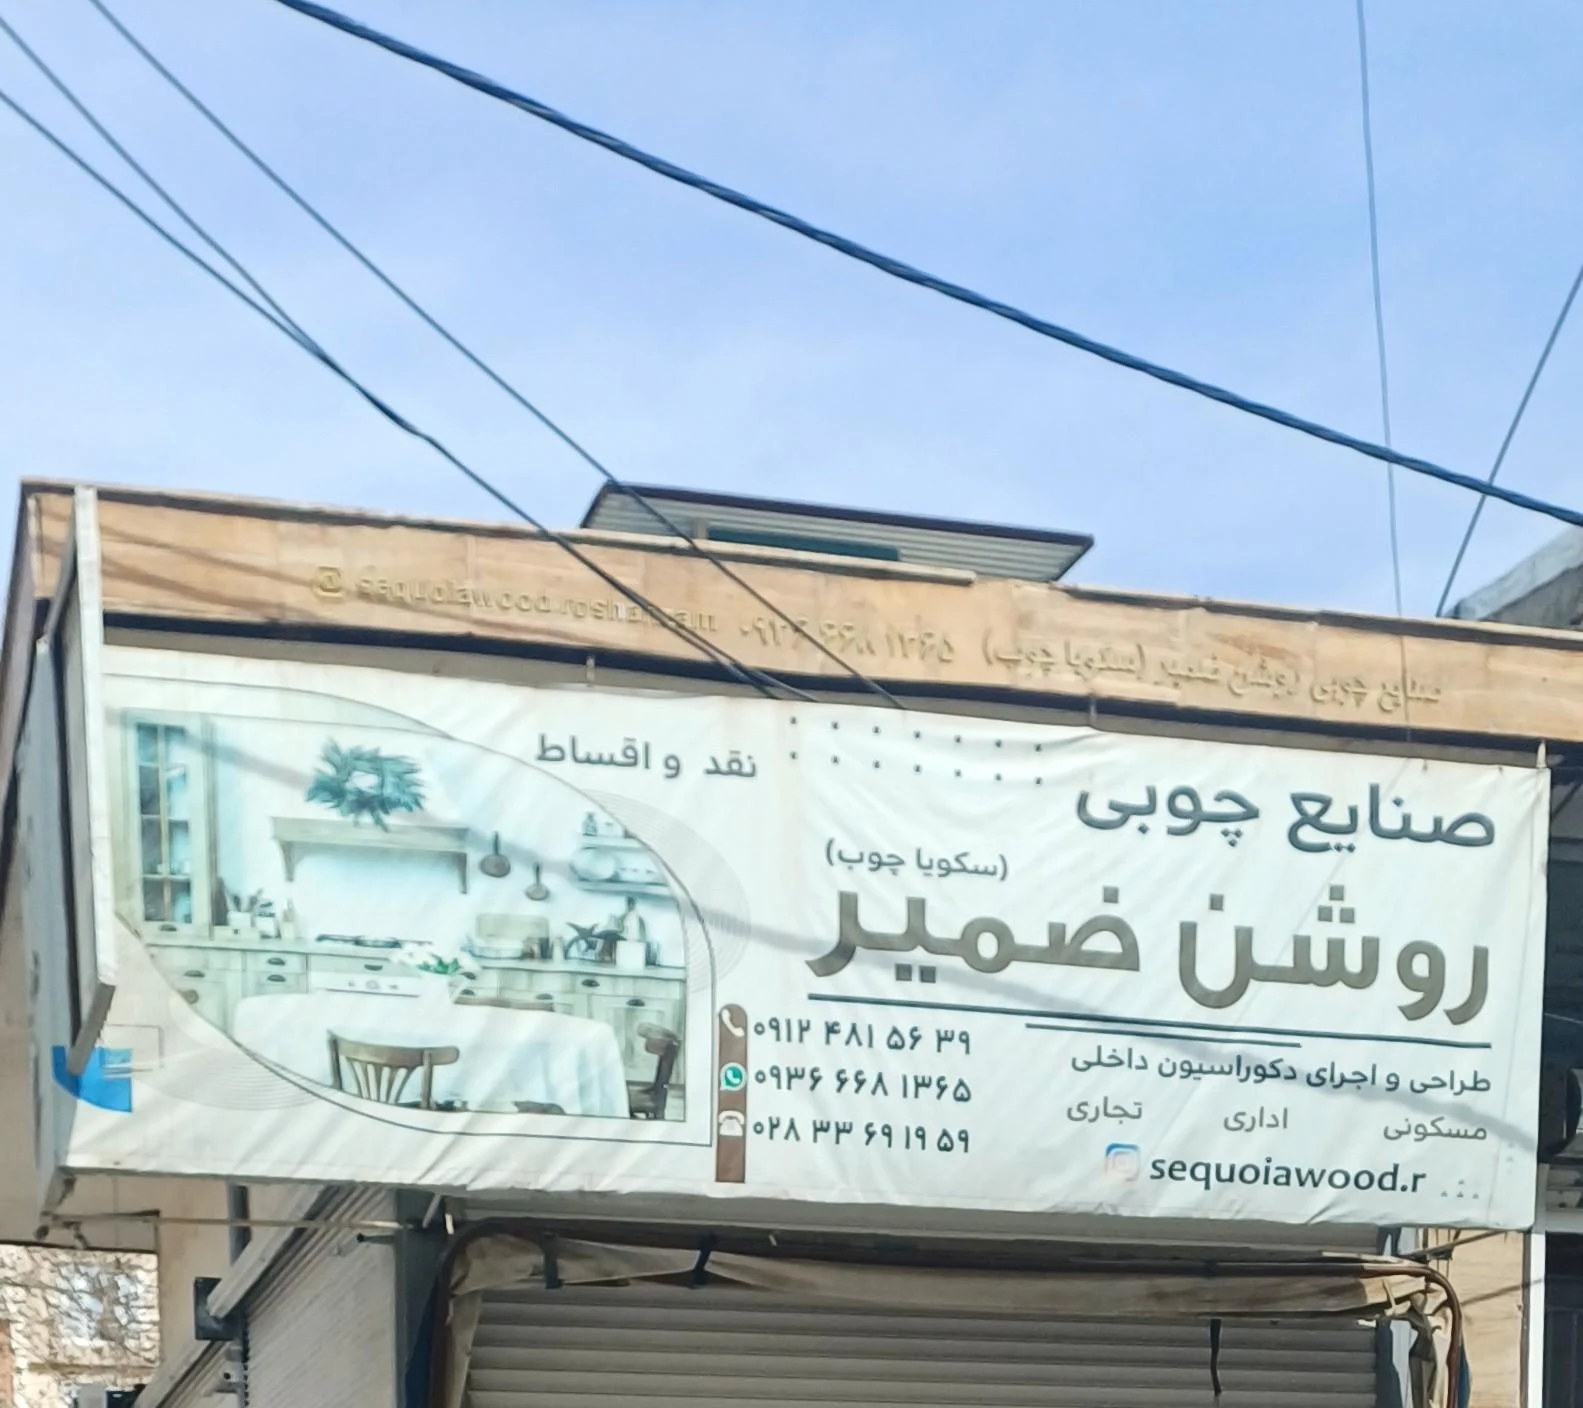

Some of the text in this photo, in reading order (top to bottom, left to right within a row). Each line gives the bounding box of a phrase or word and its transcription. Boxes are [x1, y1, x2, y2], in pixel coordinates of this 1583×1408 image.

[536, 733, 757, 779] نقد و اقساط
[1075, 783, 1497, 853] صنایع چوبی
[804, 884, 1490, 1025] روشن ضمیر
[754, 1016, 811, 1044] ۰۹۱۲
[824, 1020, 874, 1049] ۴۸۱
[755, 1065, 972, 1103] ۰۹۳۶ ۶۶۸ ۱۳۶۵
[1071, 1045, 1492, 1096] طراحی و اجرای دکوراسیون داخلی
[753, 1116, 801, 1142] ۰۲۸
[1067, 1096, 1143, 1124] تجاری
[1223, 1106, 1289, 1132] اداری
[1383, 1115, 1488, 1142] مسکونی
[1149, 1156, 1428, 1194] sequoiawood.r
